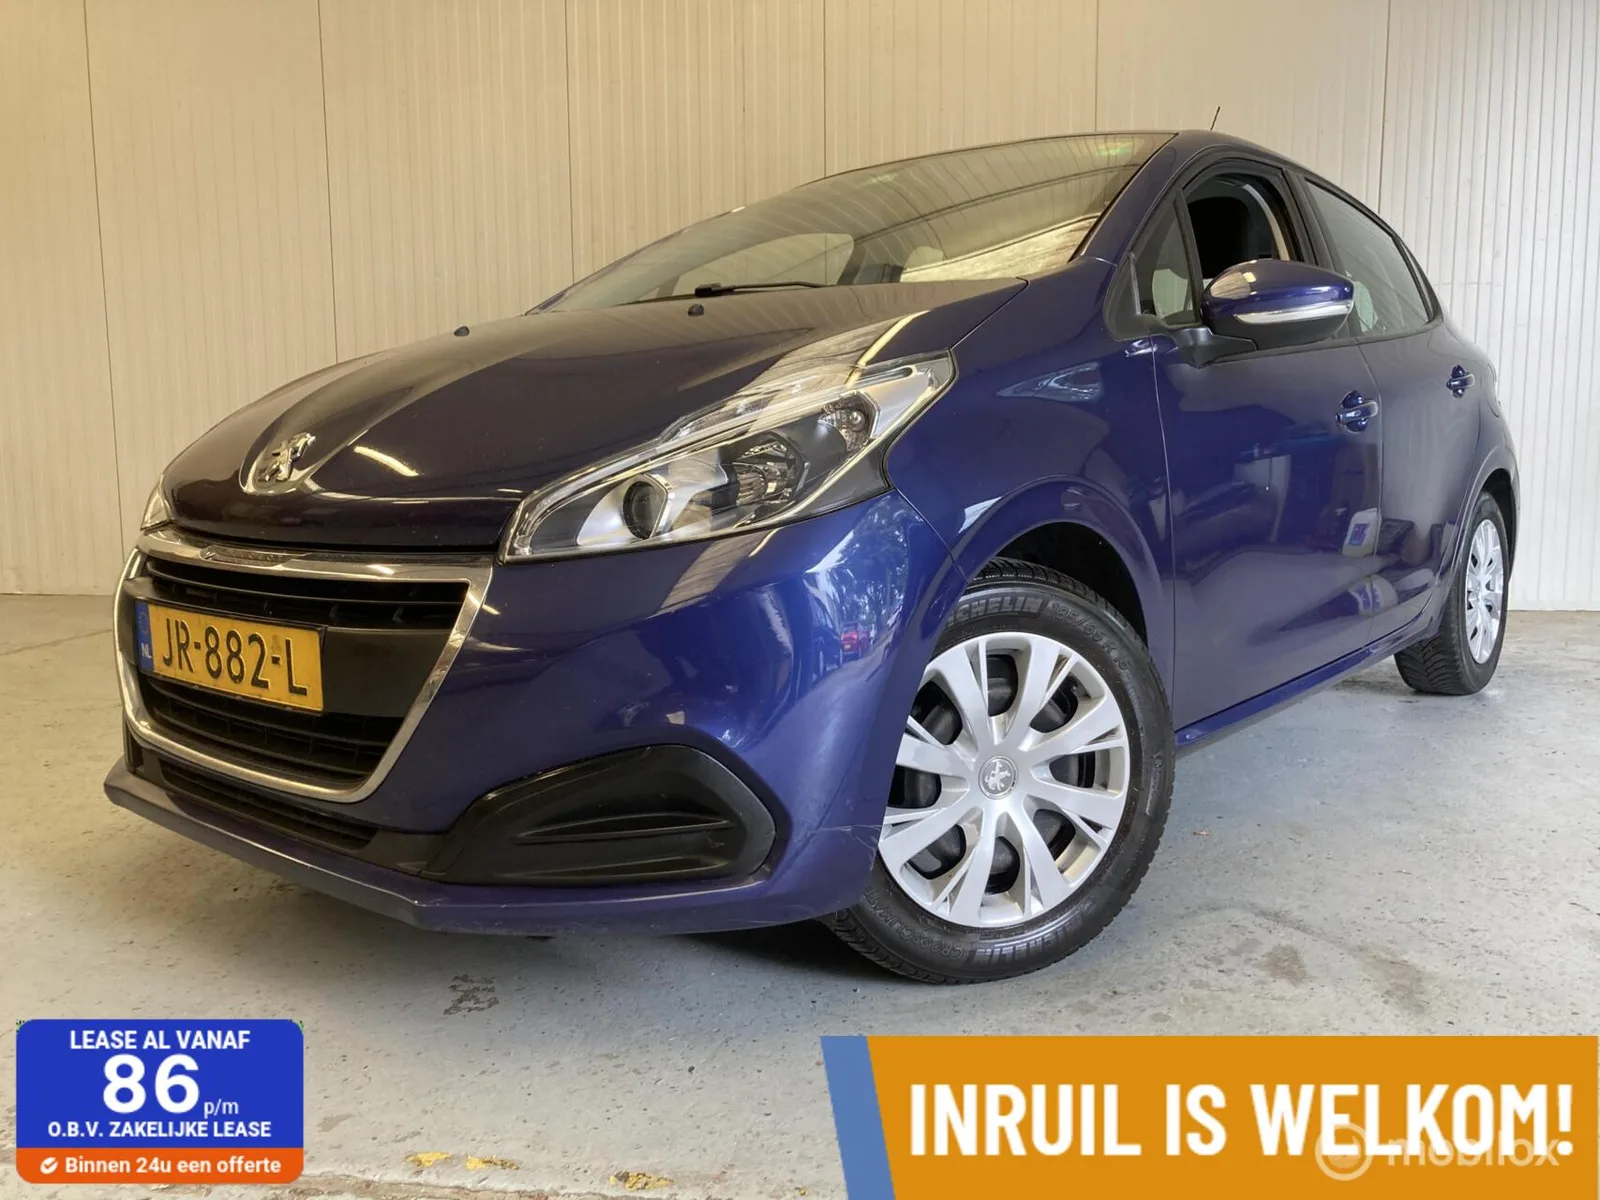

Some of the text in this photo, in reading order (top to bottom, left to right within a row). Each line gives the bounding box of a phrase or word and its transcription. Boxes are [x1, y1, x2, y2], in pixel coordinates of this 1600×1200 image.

[946, 595, 1043, 629] ICHELIN
[141, 643, 153, 660] NL
[162, 618, 308, 697] JR-882-L
